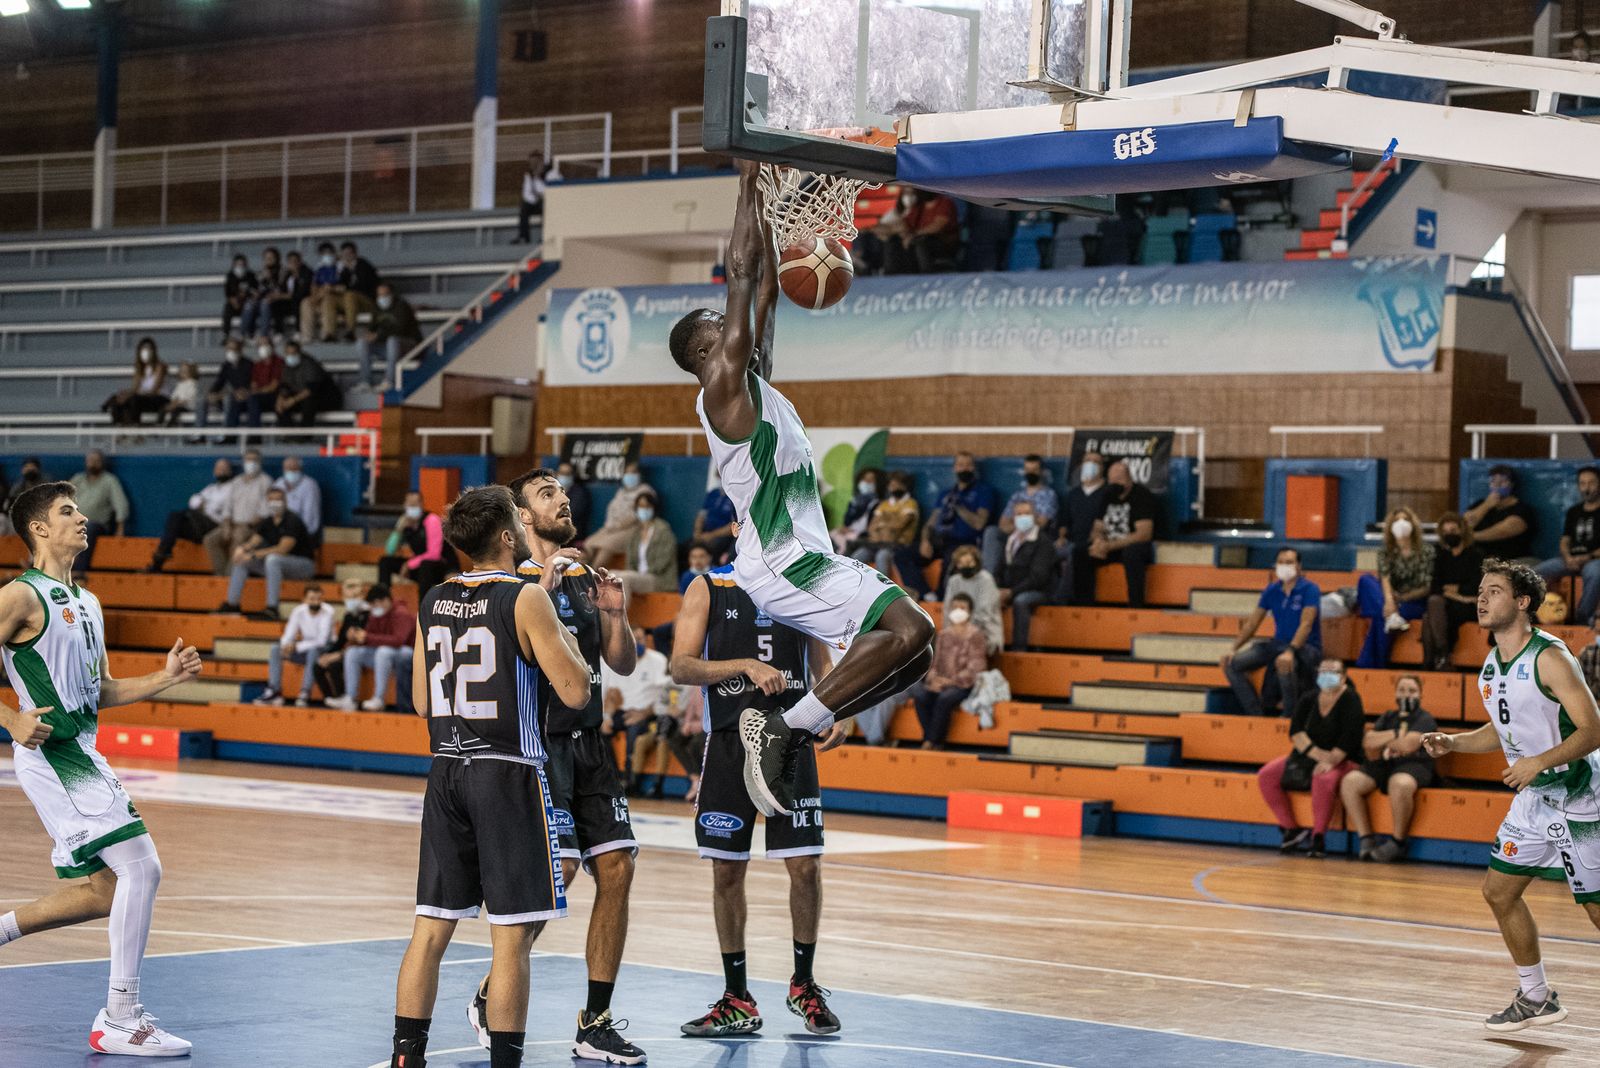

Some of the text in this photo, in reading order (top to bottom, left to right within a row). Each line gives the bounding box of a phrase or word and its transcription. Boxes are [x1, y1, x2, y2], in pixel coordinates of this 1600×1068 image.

[1114, 127, 1157, 160] GES
[433, 599, 489, 619] ROBERTSON
[757, 635, 774, 662] 5
[427, 625, 499, 720] 22
[1498, 698, 1510, 725] 6
[706, 814, 734, 828] Ford
[547, 814, 565, 898] ENRIQUE
[1561, 851, 1576, 878] 6
